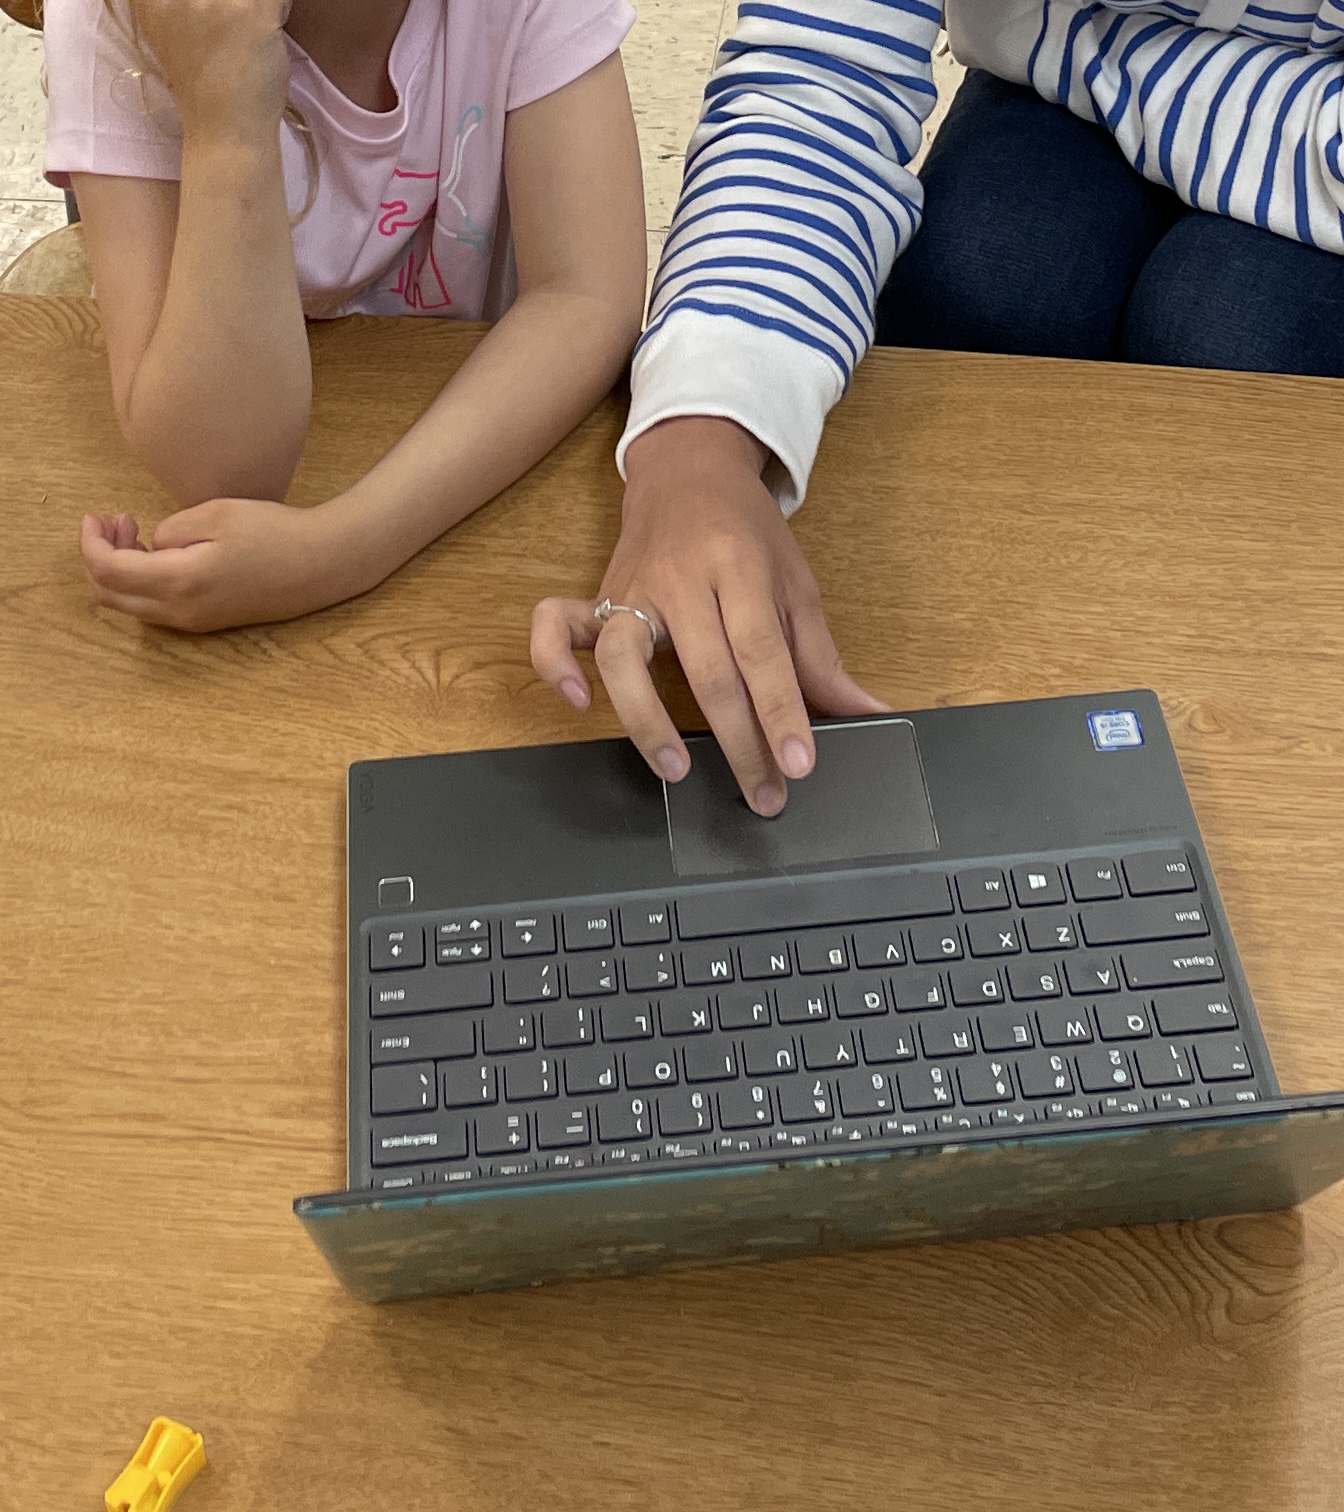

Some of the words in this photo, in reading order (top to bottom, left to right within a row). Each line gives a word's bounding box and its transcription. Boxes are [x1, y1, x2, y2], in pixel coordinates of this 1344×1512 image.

[1097, 870, 1111, 880] Fn
[1166, 862, 1186, 873] Ctrl
[984, 881, 1000, 891] Alt
[648, 913, 663, 924] Alt
[1174, 910, 1201, 922] Shift
[587, 918, 607, 931] Ctrl
[998, 932, 1014, 948] X
[1056, 927, 1071, 943] Z
[886, 944, 900, 960] V
[941, 938, 956, 954] C
[770, 954, 785, 971] N
[828, 949, 843, 965] B
[1172, 955, 1215, 969] CapsLk
[711, 960, 728, 977] M
[1040, 975, 1055, 991] S
[1096, 969, 1110, 985] A
[379, 989, 405, 1002] Shift
[927, 986, 939, 1003] F
[982, 980, 997, 997] D
[752, 1004, 763, 1021] J
[807, 998, 823, 1015] H
[1207, 1003, 1229, 1014] Tab
[635, 1016, 647, 1032] L
[691, 1010, 706, 1027] K
[1126, 1015, 1144, 1031] Q
[1012, 1026, 1028, 1043] E
[1066, 1020, 1087, 1038] W
[381, 1036, 410, 1049] Enter
[896, 1038, 909, 1055] T
[776, 1050, 791, 1068] U
[836, 1044, 850, 1061] Y
[1108, 1050, 1121, 1065] 2
[1169, 1045, 1179, 1060] 1
[598, 1068, 612, 1086] P
[655, 1062, 671, 1080] O
[930, 1067, 942, 1083] 5
[990, 1062, 1002, 1078] 4
[813, 1080, 824, 1096] 7
[631, 1098, 643, 1115] 0
[691, 1092, 703, 1109] 9
[381, 1133, 438, 1149] Backspace
